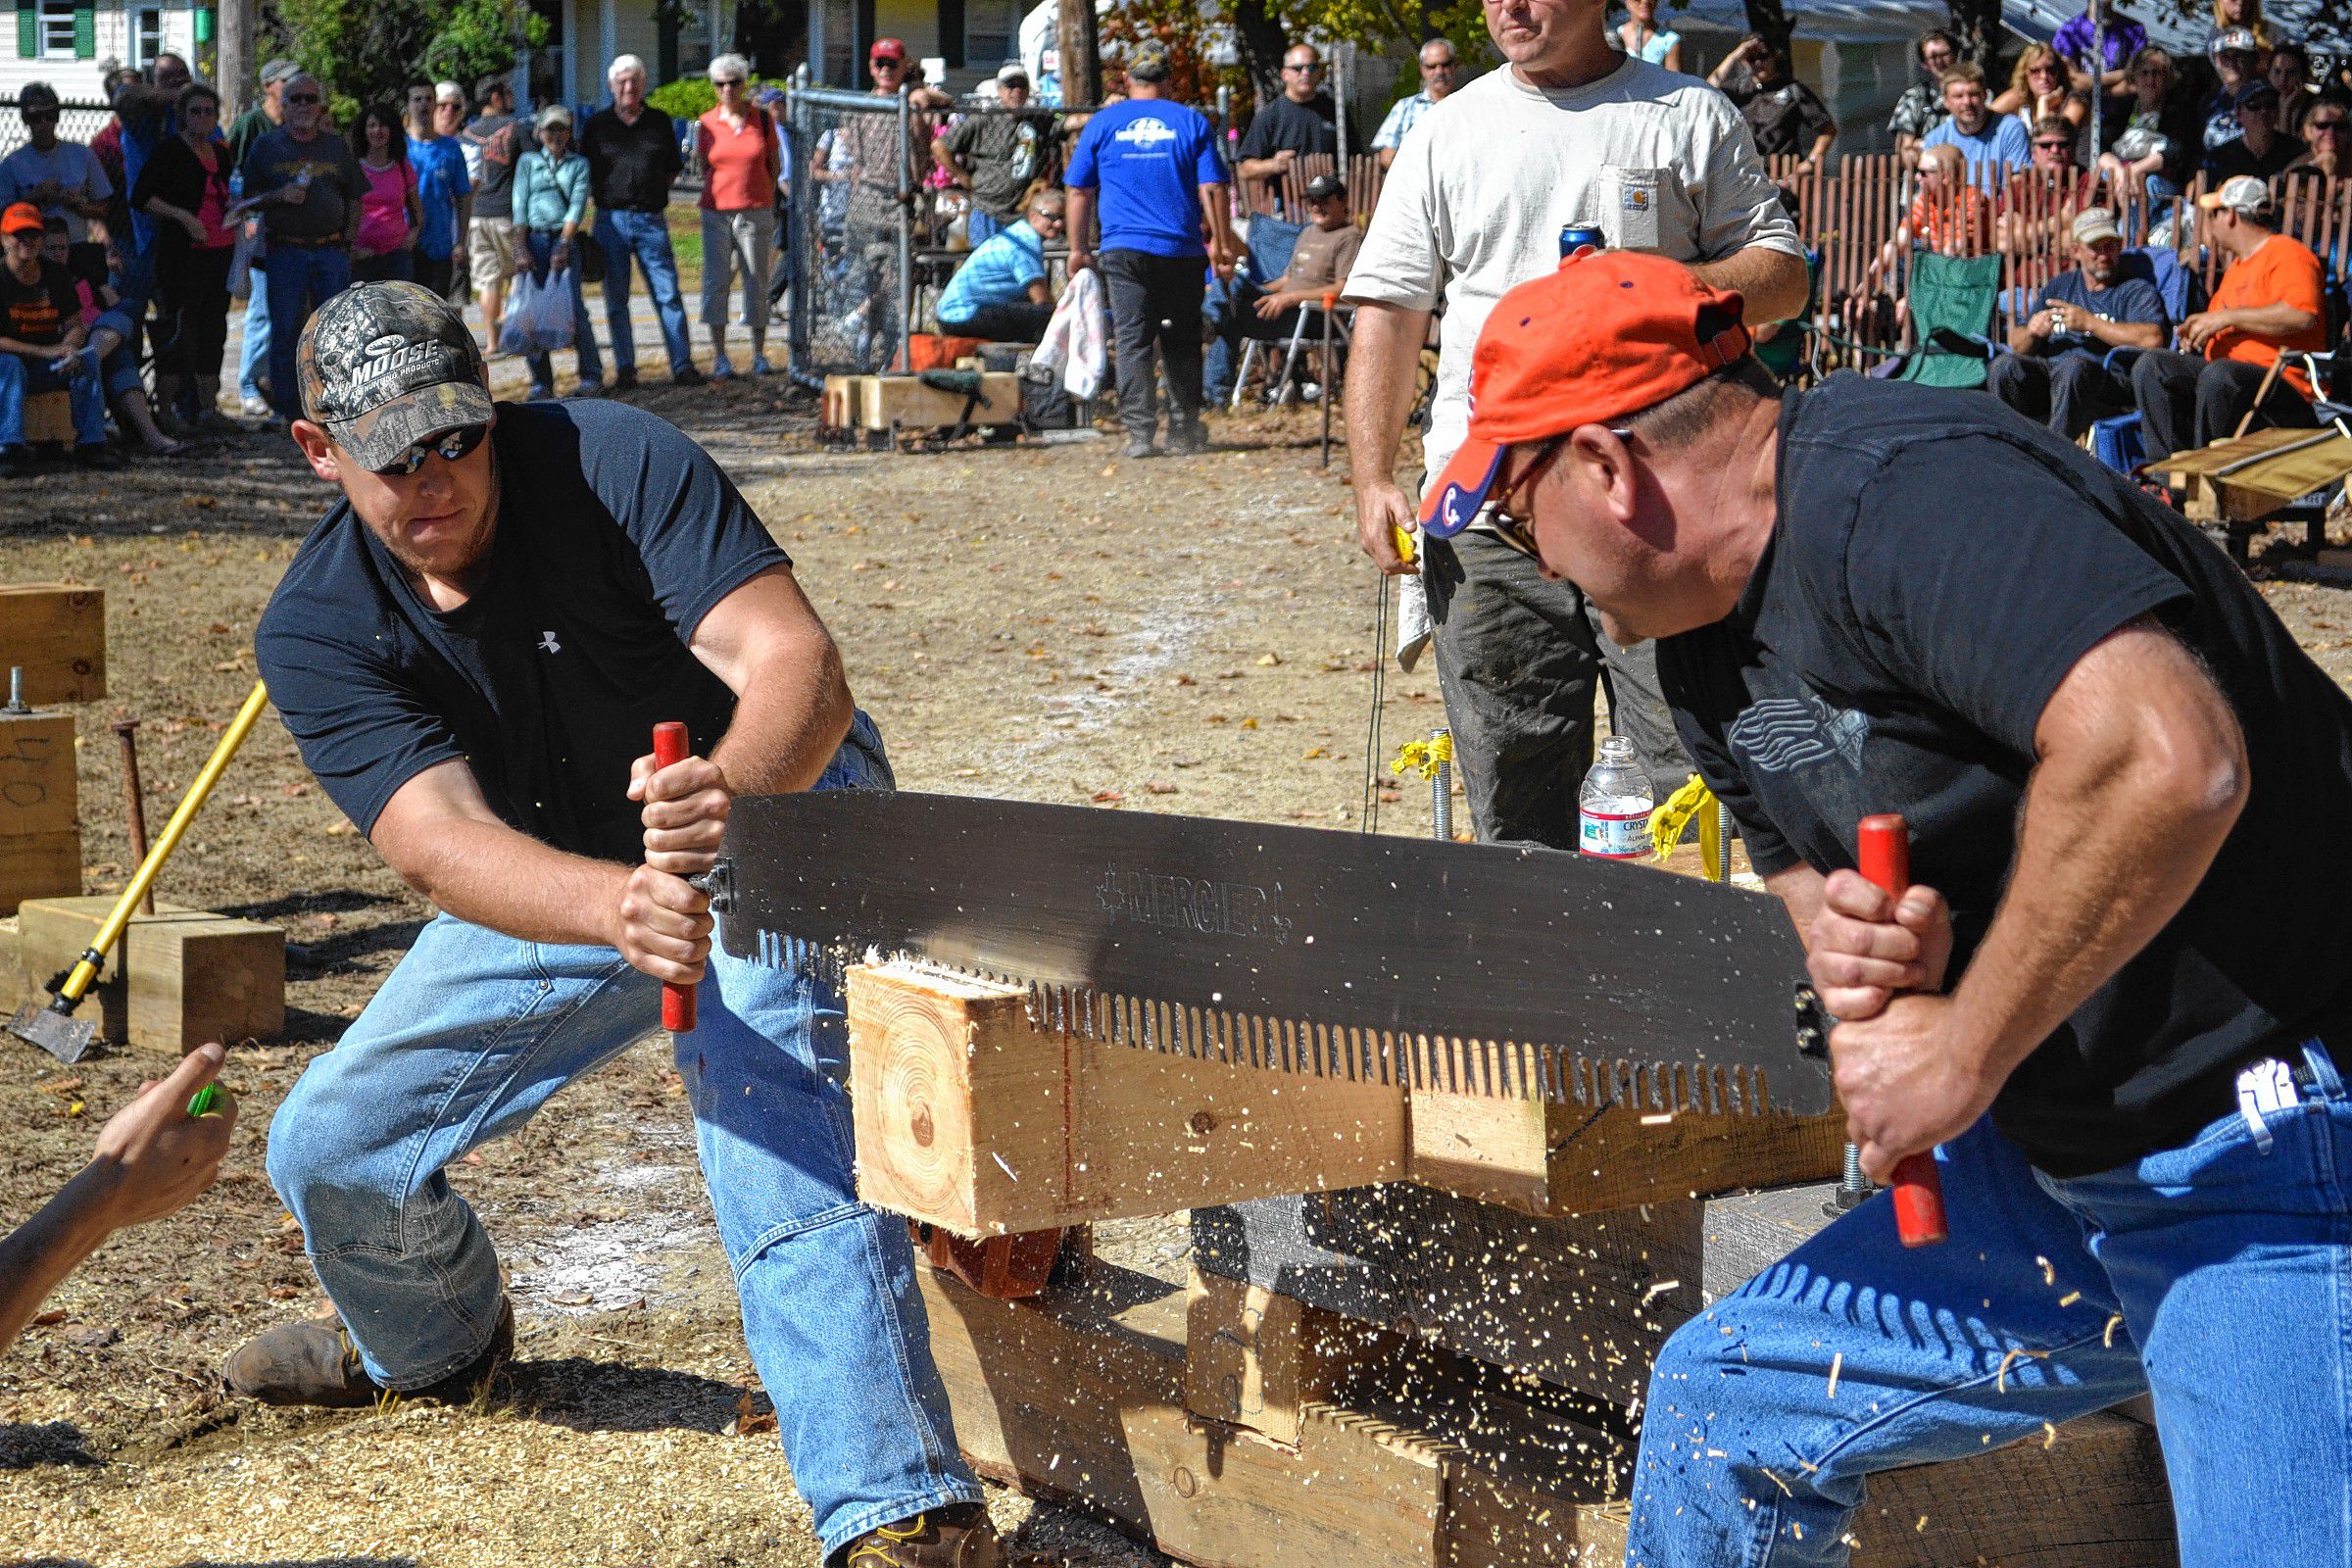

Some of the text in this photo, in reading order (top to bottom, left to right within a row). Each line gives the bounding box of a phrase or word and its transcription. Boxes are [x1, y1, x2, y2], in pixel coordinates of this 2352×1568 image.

[352, 338, 438, 388] MOOSE
[400, 358, 439, 376] PRODUCTS
[1128, 870, 1268, 938] MERCIER
